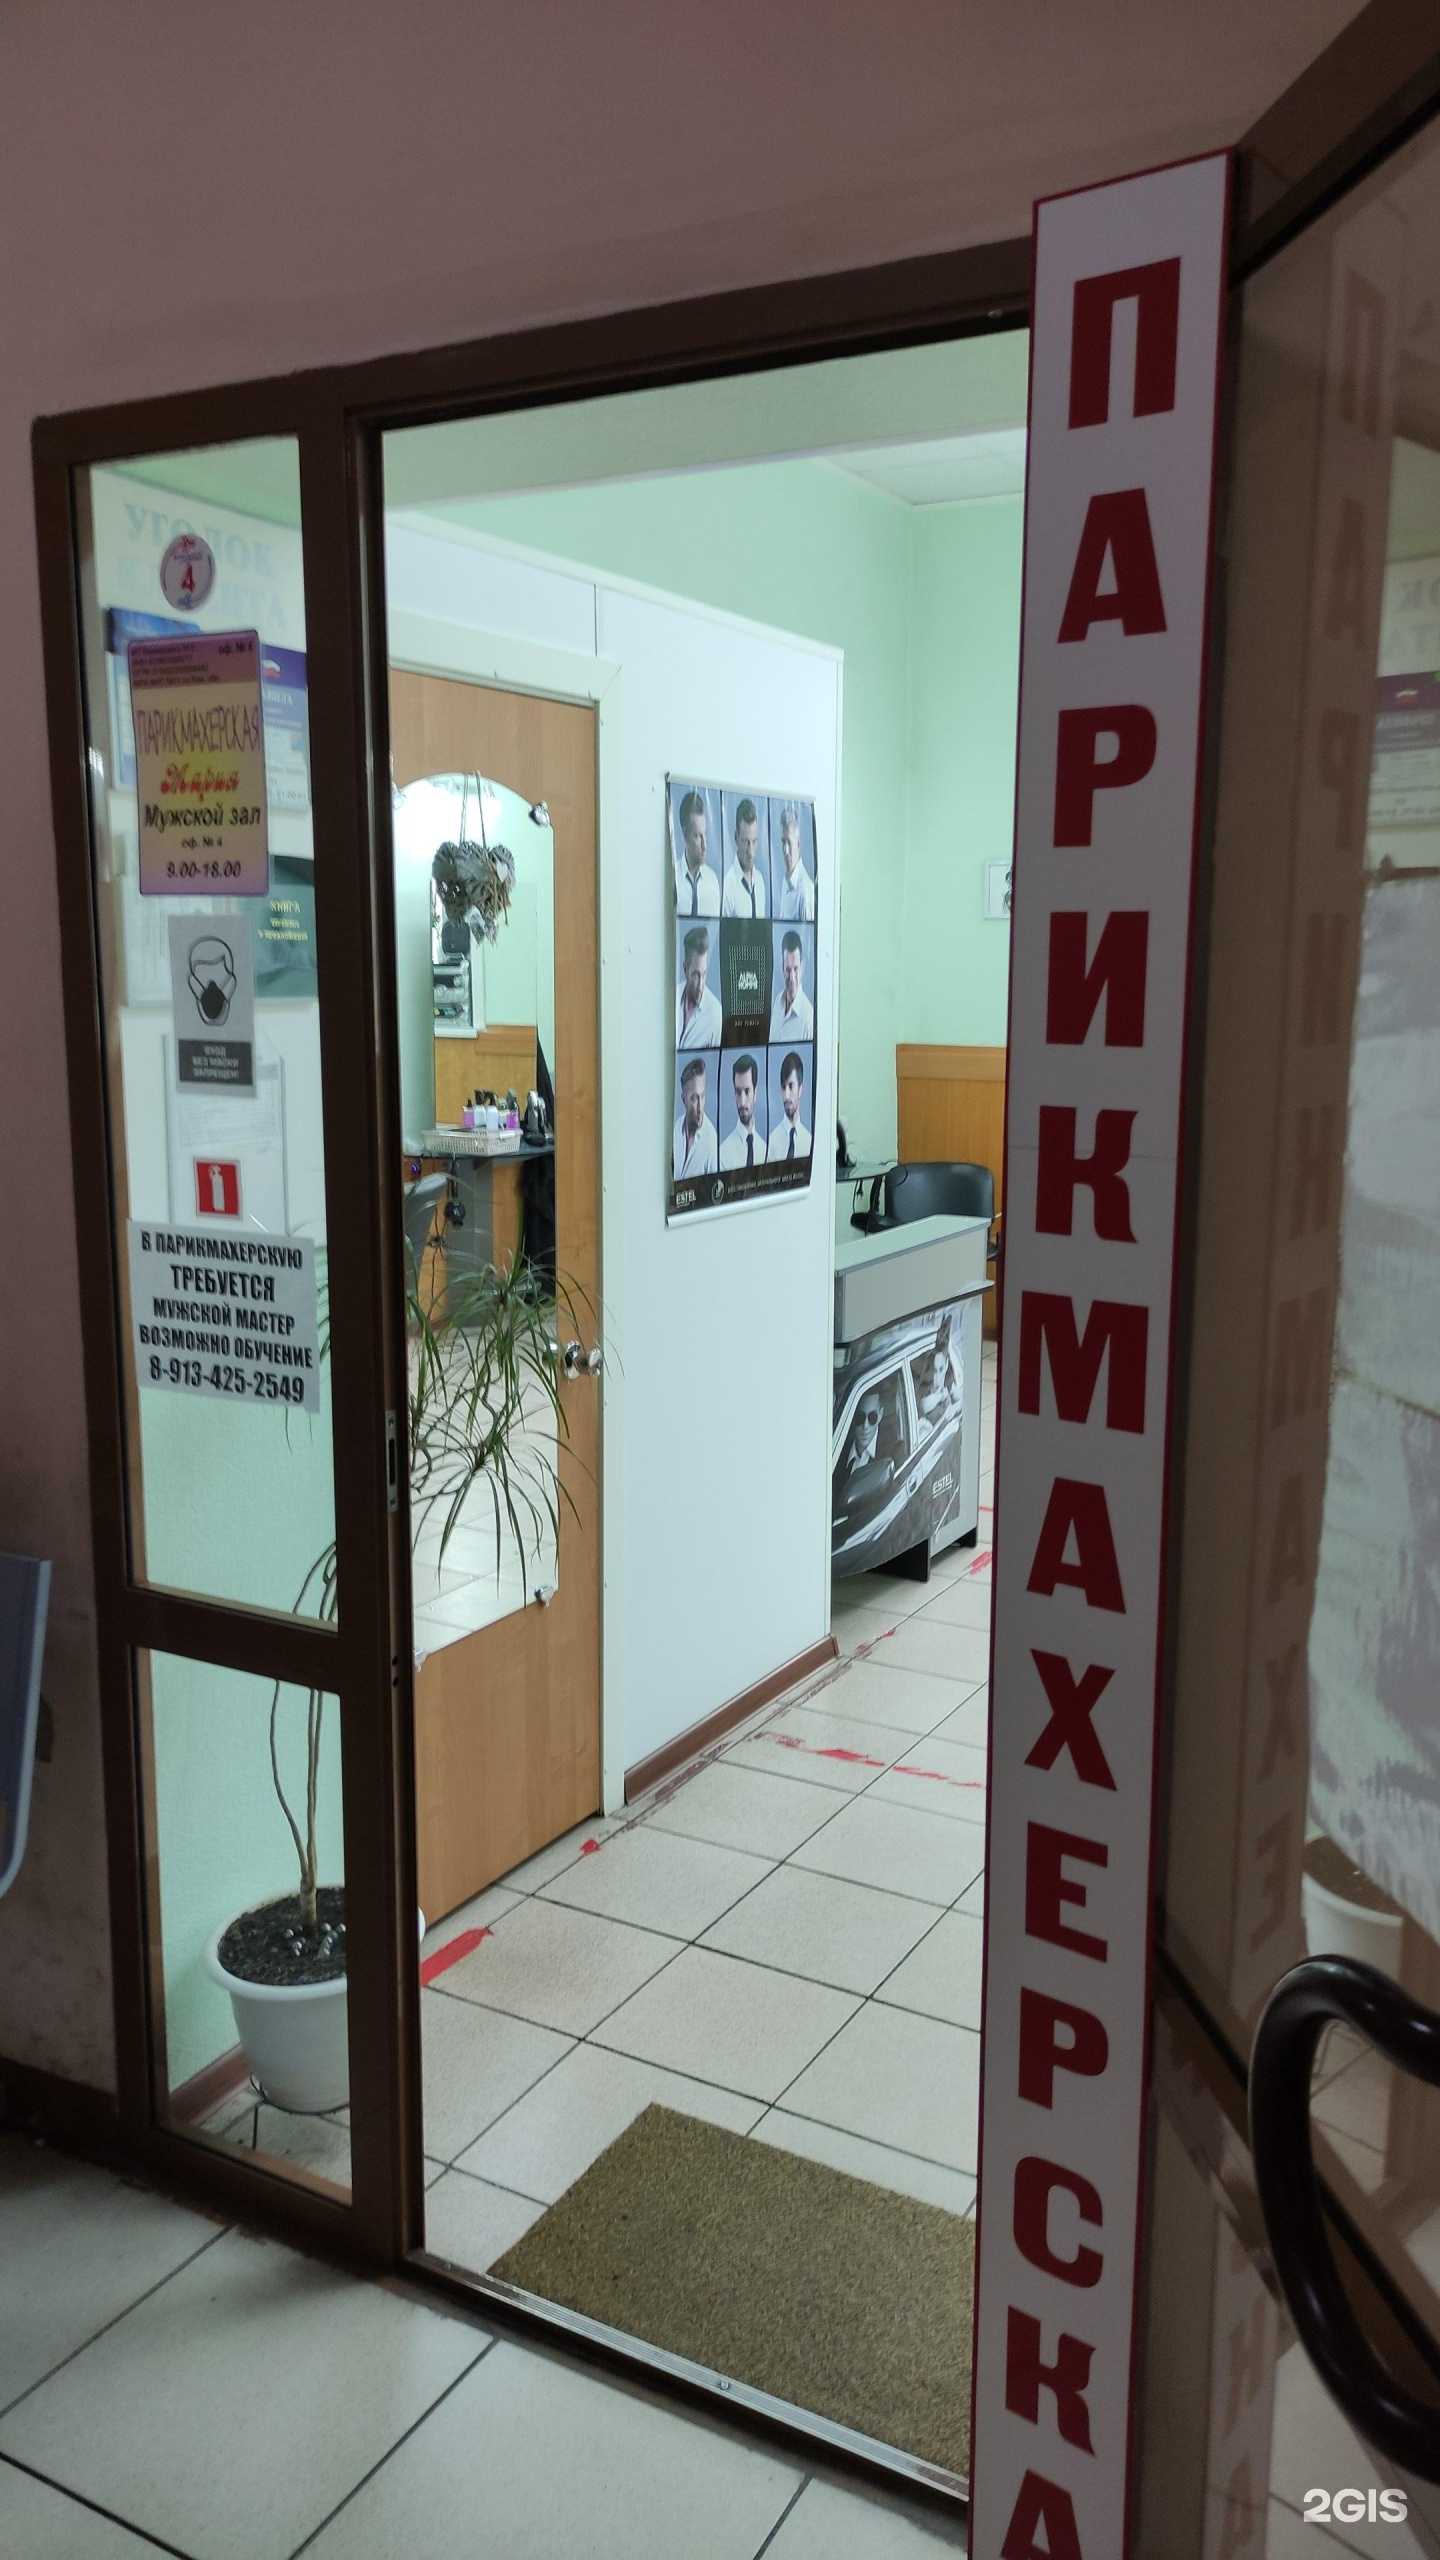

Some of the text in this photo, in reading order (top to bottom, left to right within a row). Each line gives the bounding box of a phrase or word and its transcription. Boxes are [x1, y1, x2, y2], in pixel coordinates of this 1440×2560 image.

[137, 704, 260, 757] ПАРИКМАХЕРСКАЯ
[144, 802, 261, 833] Мужской зал
[167, 860, 242, 879] 9.00-18.00
[141, 1230, 304, 1270] В ПАРИКМАХЕРСКУЮ
[170, 1264, 276, 1303] ТРЕБУЕТСЯ
[152, 1297, 296, 1337] МУЖСКОЙ МАСТЕР
[138, 1323, 314, 1370] ВОЗМОЖНО ОБУЧЕНИЕ
[150, 1354, 306, 1404] 8-913-425-2549
[1001, 256, 1181, 2560] ПАРИКМАХЕРСКА
